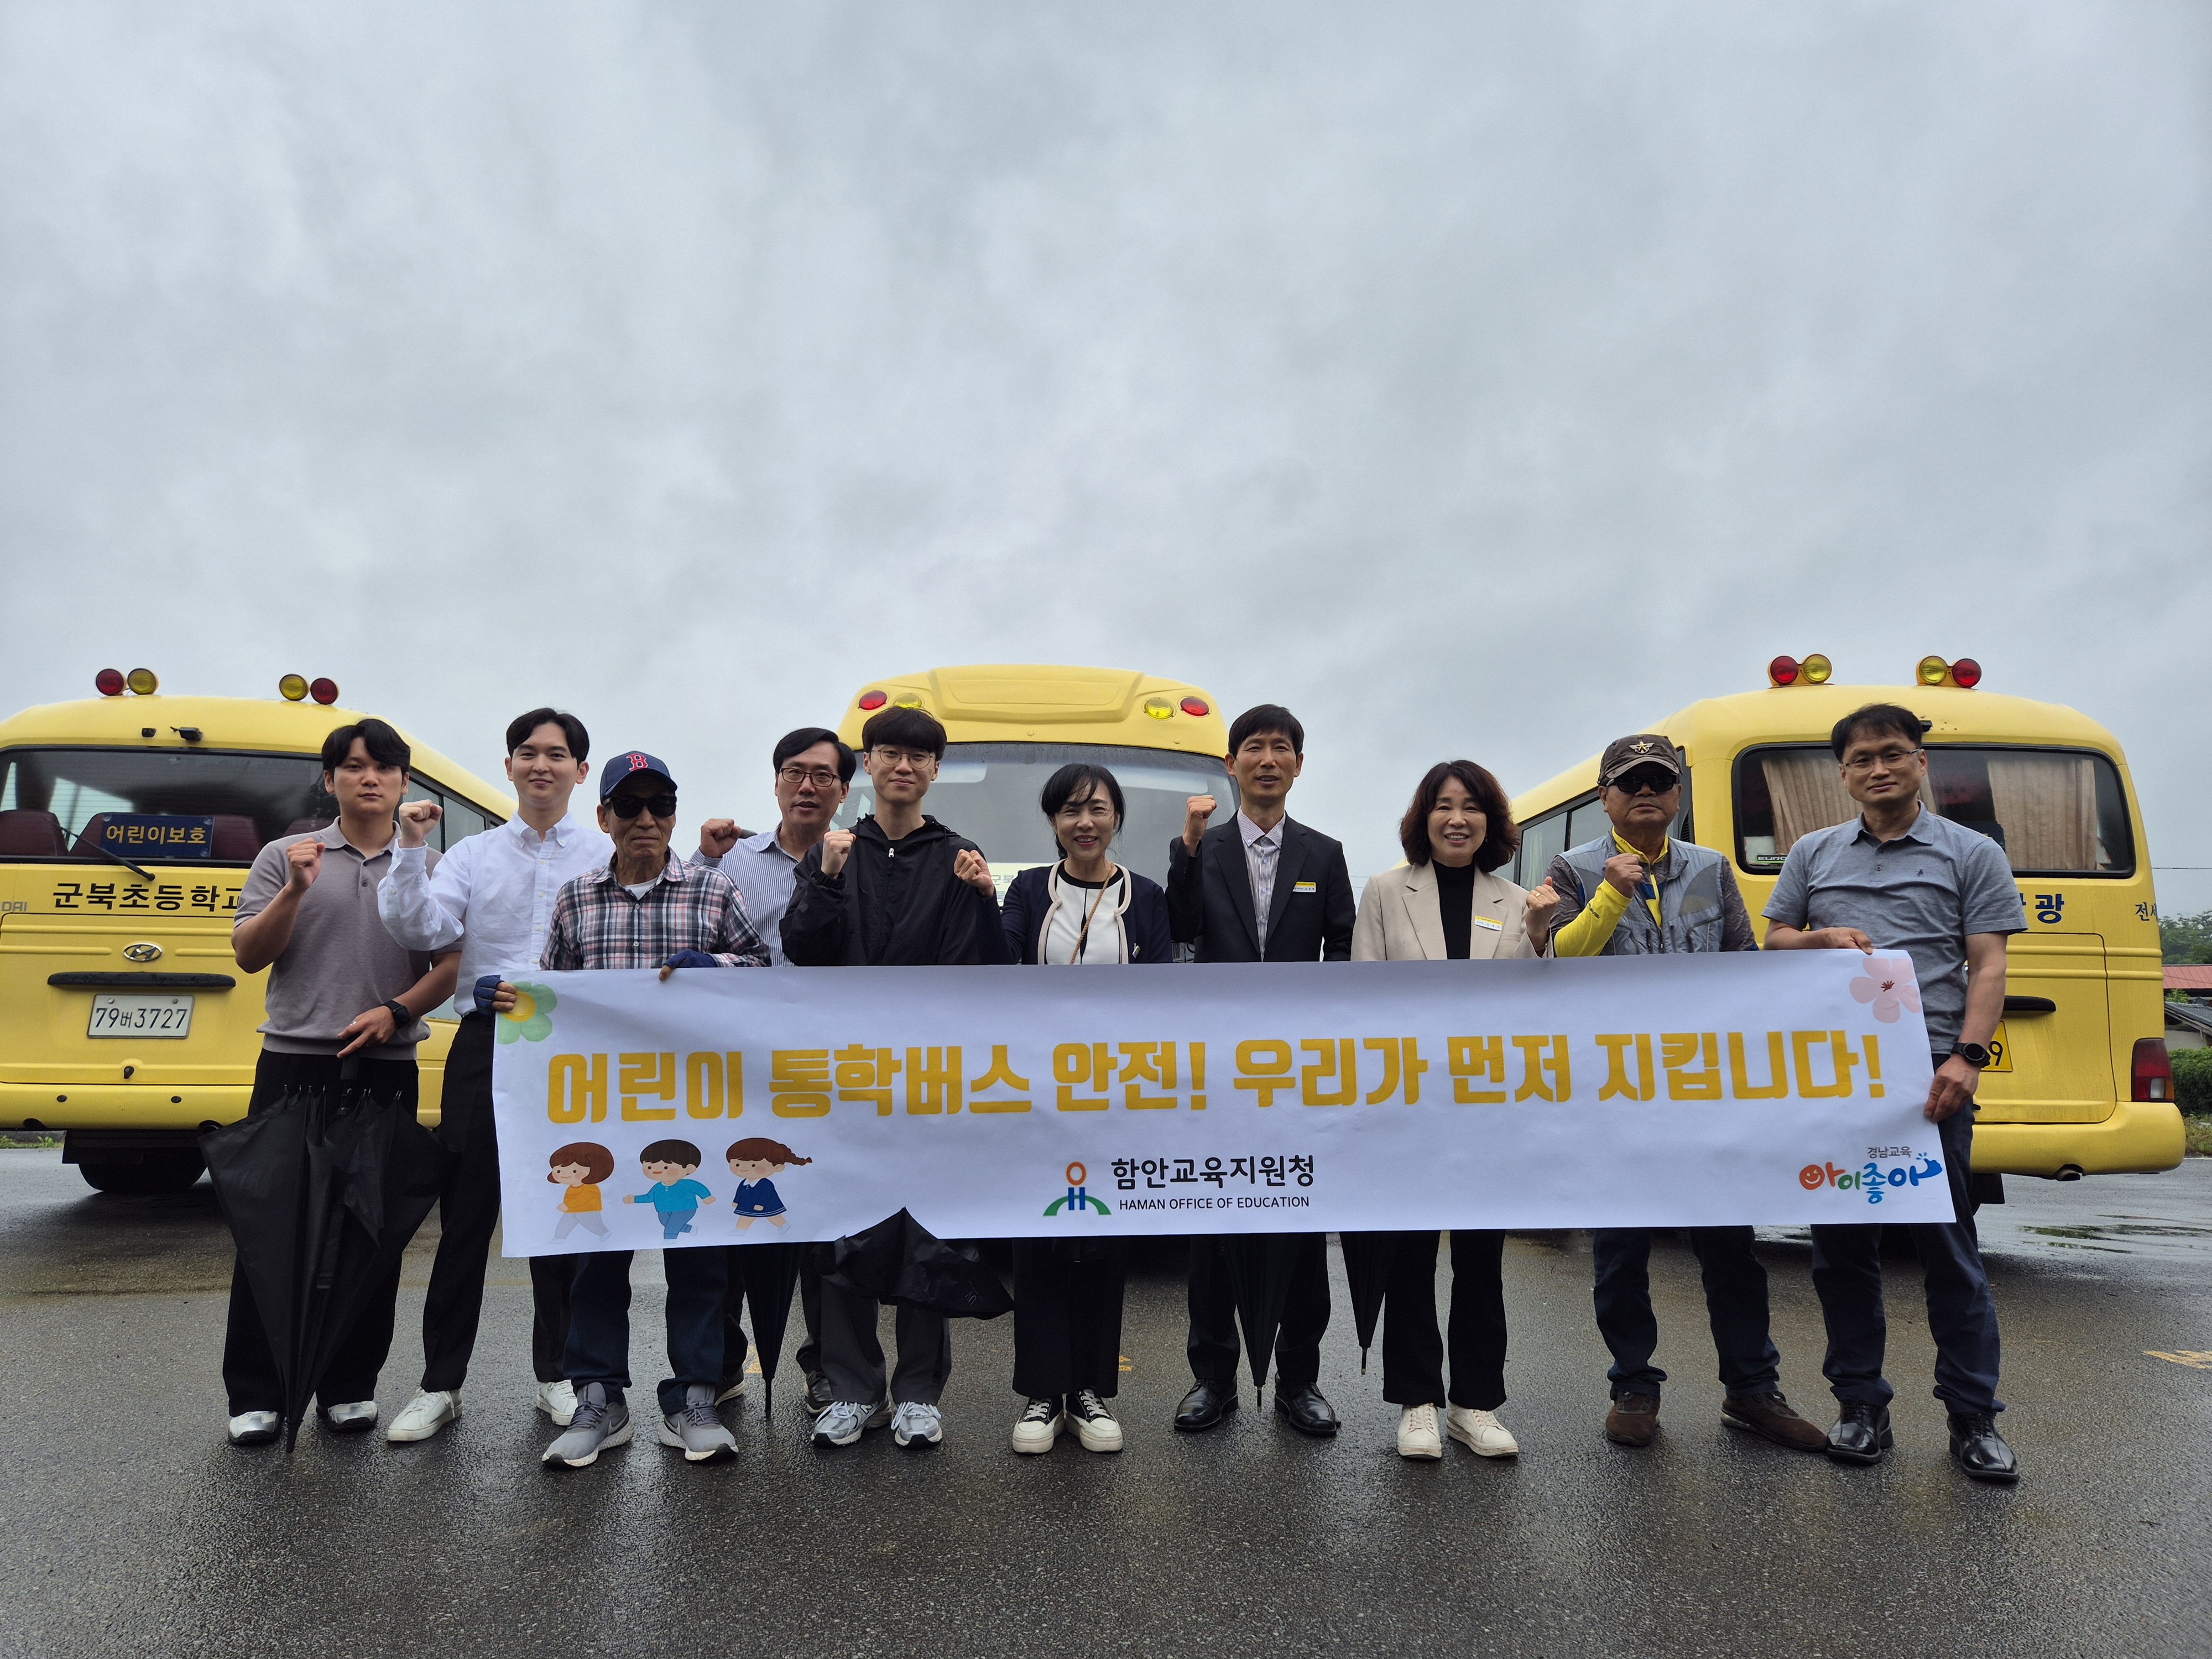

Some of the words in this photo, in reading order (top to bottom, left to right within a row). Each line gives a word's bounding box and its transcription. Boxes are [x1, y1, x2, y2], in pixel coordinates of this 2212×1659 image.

[625, 753, 649, 771] B
[106, 826, 206, 844] 어린이보호
[2020, 893, 2065, 924] 광
[95, 1007, 189, 1030] 79버3727
[547, 1051, 743, 1124] 어린이
[769, 1044, 1032, 1118] 통학버스
[1052, 1041, 1207, 1112] 안전!
[1233, 1037, 1428, 1107] 우리가
[1447, 1035, 1571, 1104] 먼저
[1595, 1030, 1885, 1102] 지킵니다!
[1867, 1146, 1912, 1159] 경남교육
[1110, 1155, 1314, 1190] 함안교육지원청
[1799, 1159, 1943, 1204] 아이좋아
[1119, 1199, 1165, 1211] HAMAN
[1169, 1198, 1213, 1210] OFFICE
[1217, 1197, 1233, 1209] OF
[1237, 1196, 1310, 1208] EDUCATION
